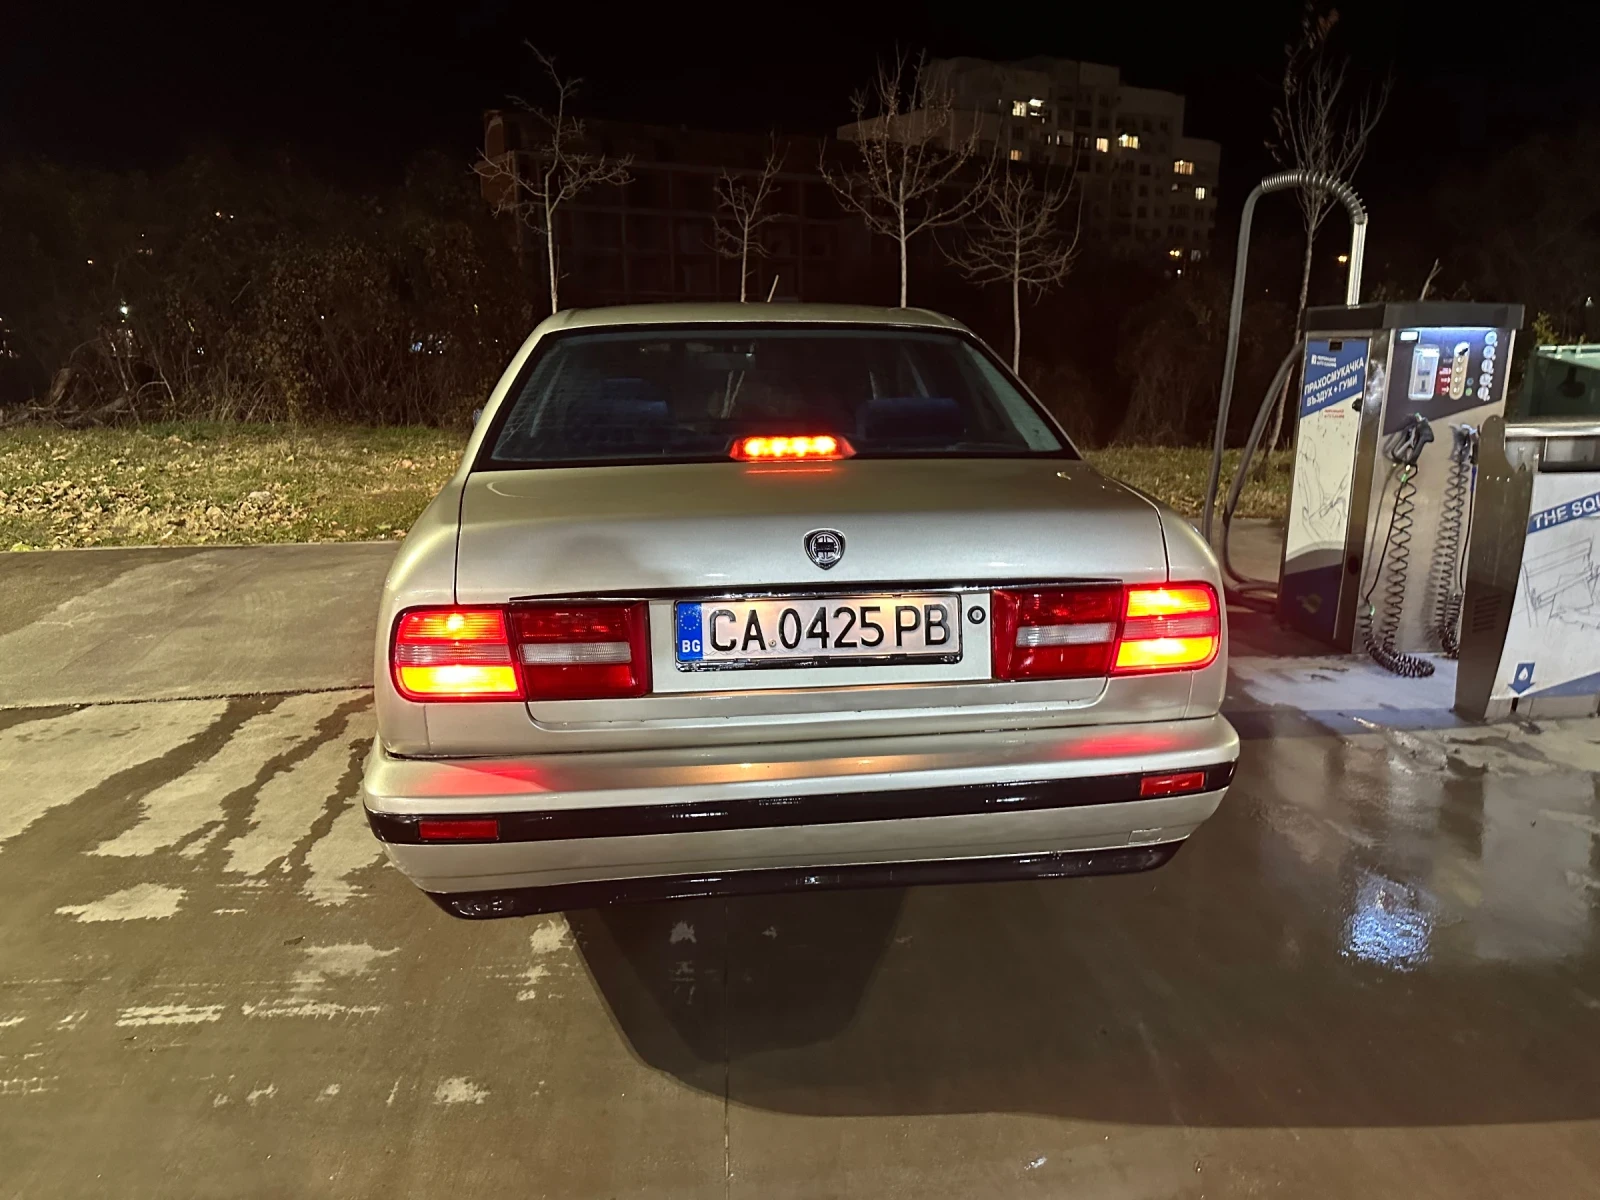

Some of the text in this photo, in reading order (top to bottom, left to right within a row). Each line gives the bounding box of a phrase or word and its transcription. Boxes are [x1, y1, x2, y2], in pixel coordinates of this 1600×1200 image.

[1304, 357, 1364, 395] ПРАХОСМУКАЧКА
[1306, 386, 1332, 407] ВЪЗДУХ
[1338, 374, 1358, 393] ГУМИ
[1533, 505, 1569, 529] THE
[708, 604, 951, 652] CA 0425 PB
[681, 639, 701, 653] BG
